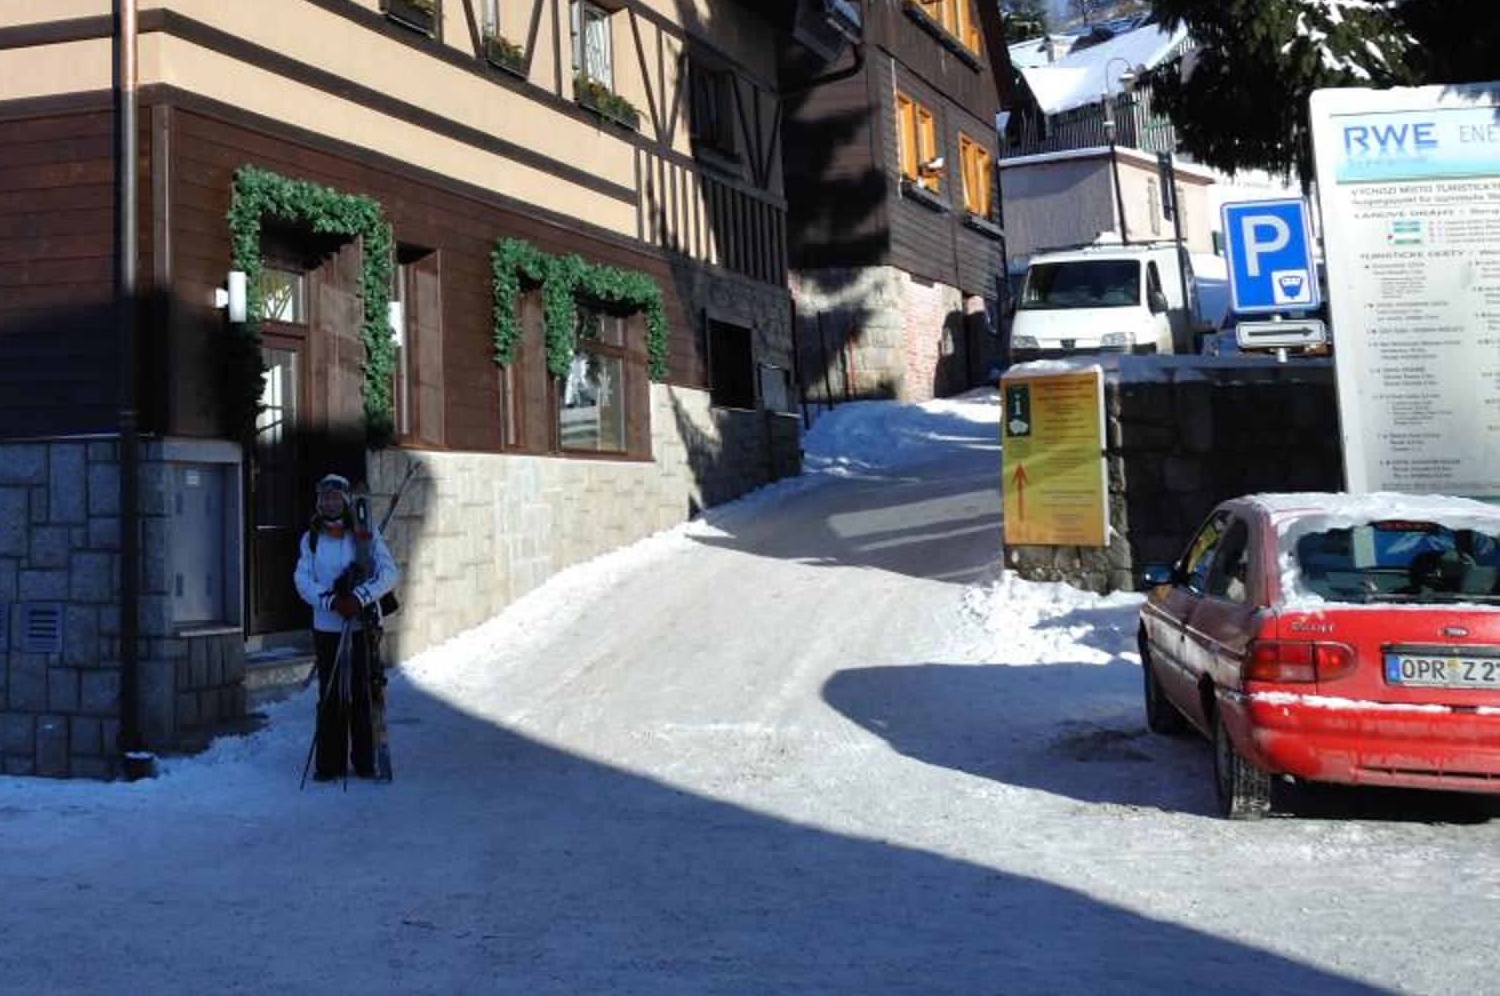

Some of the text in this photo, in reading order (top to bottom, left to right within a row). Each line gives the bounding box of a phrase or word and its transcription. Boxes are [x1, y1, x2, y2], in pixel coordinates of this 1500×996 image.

[1343, 122, 1438, 151] RWE
[1241, 215, 1291, 277] P
[1402, 659, 1445, 680] OPR
